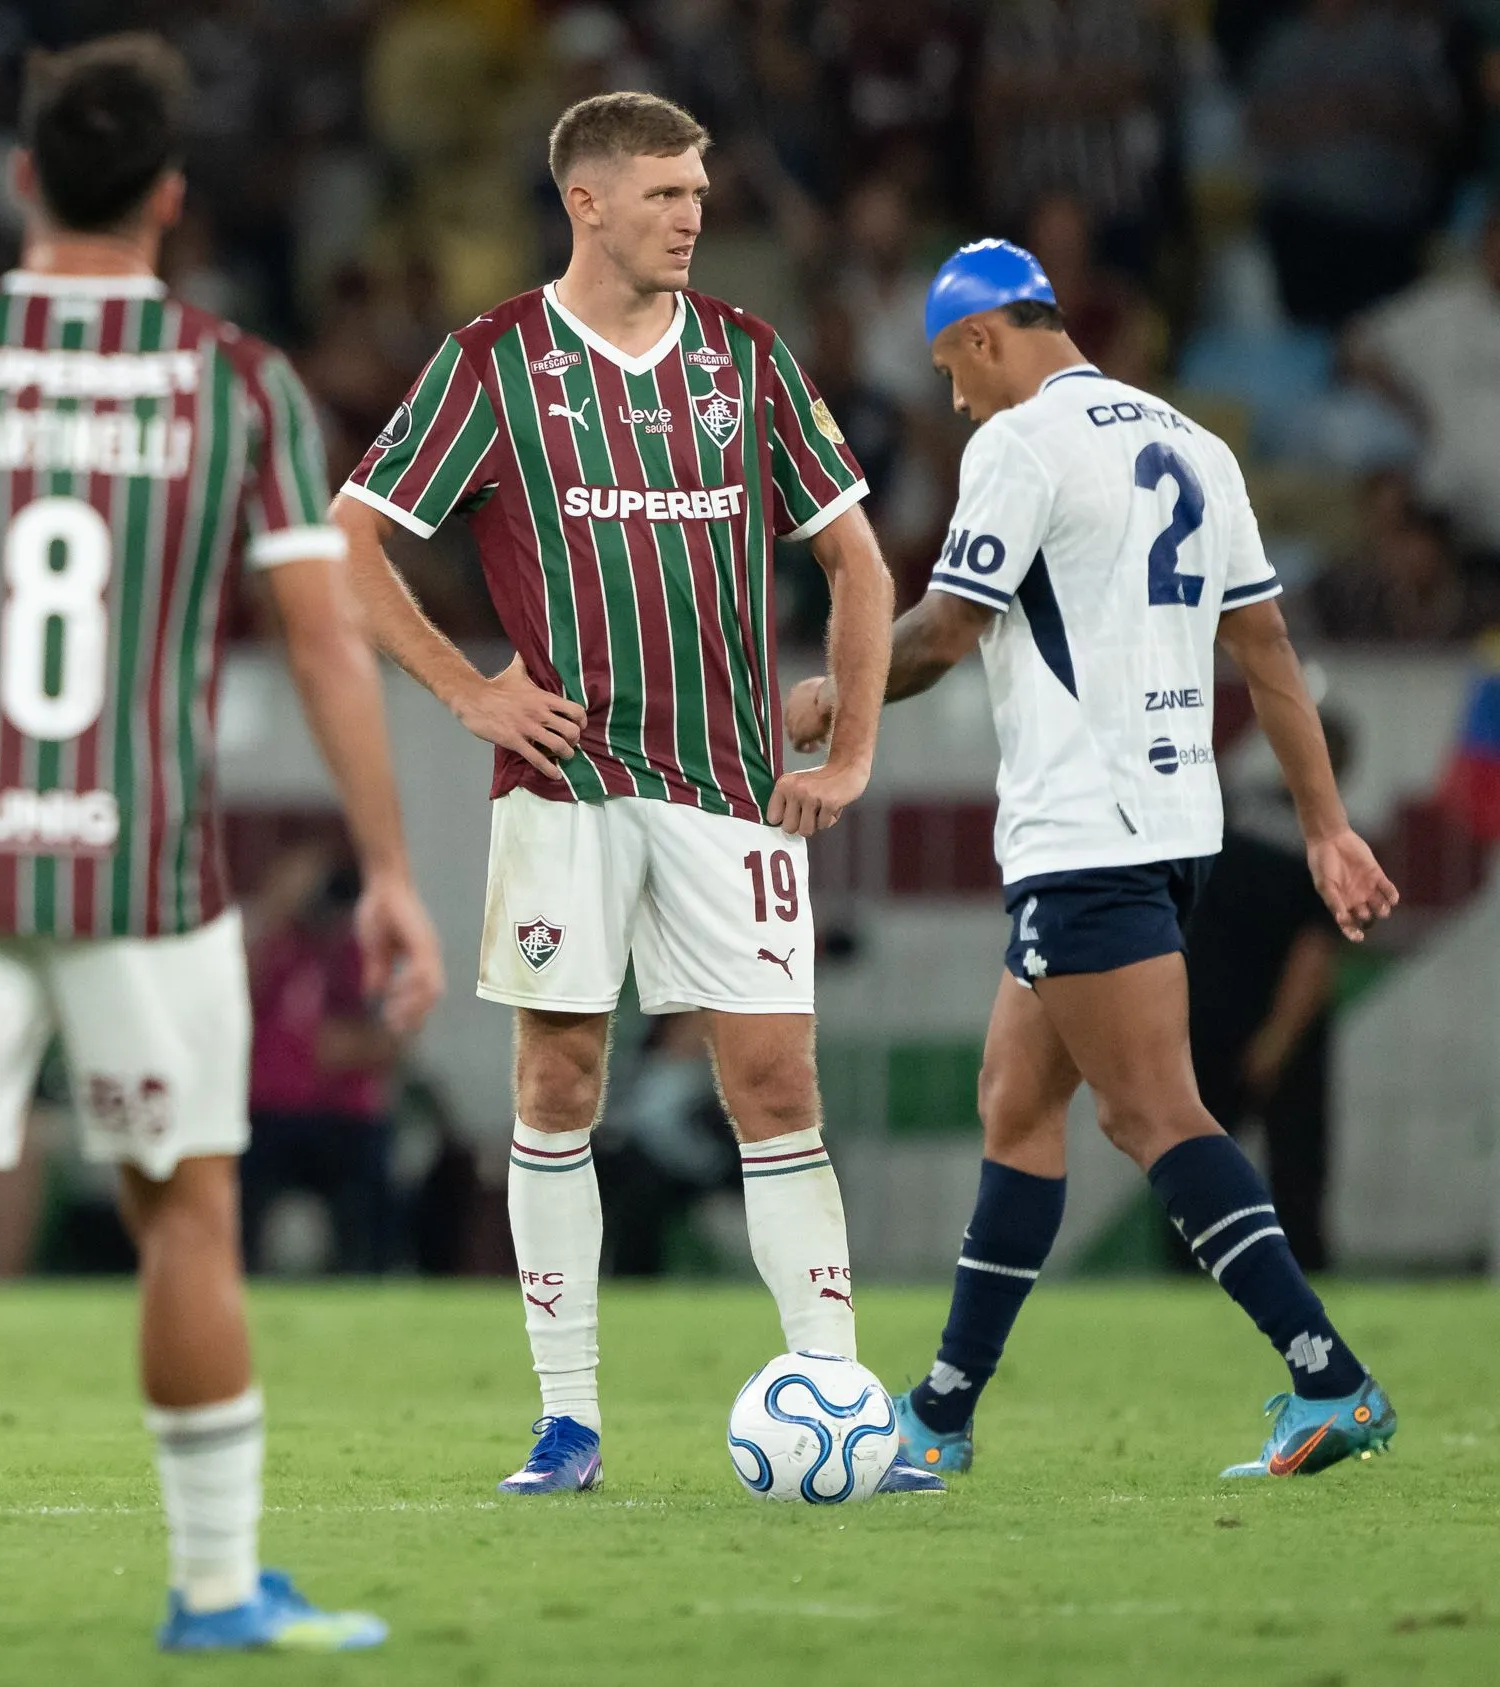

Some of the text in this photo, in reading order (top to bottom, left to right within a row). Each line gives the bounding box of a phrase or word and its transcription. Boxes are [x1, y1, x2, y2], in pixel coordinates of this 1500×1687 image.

[533, 354, 580, 371] FRESCATTO
[688, 353, 730, 365] FRESCATTO
[618, 405, 672, 424] Leve
[645, 421, 673, 435] saúde
[563, 484, 743, 520] SUPERBET
[1135, 441, 1205, 608] 2
[0, 496, 111, 741] 8
[743, 849, 798, 922] 19
[1020, 894, 1039, 941] 2
[521, 1271, 564, 1286] FFC
